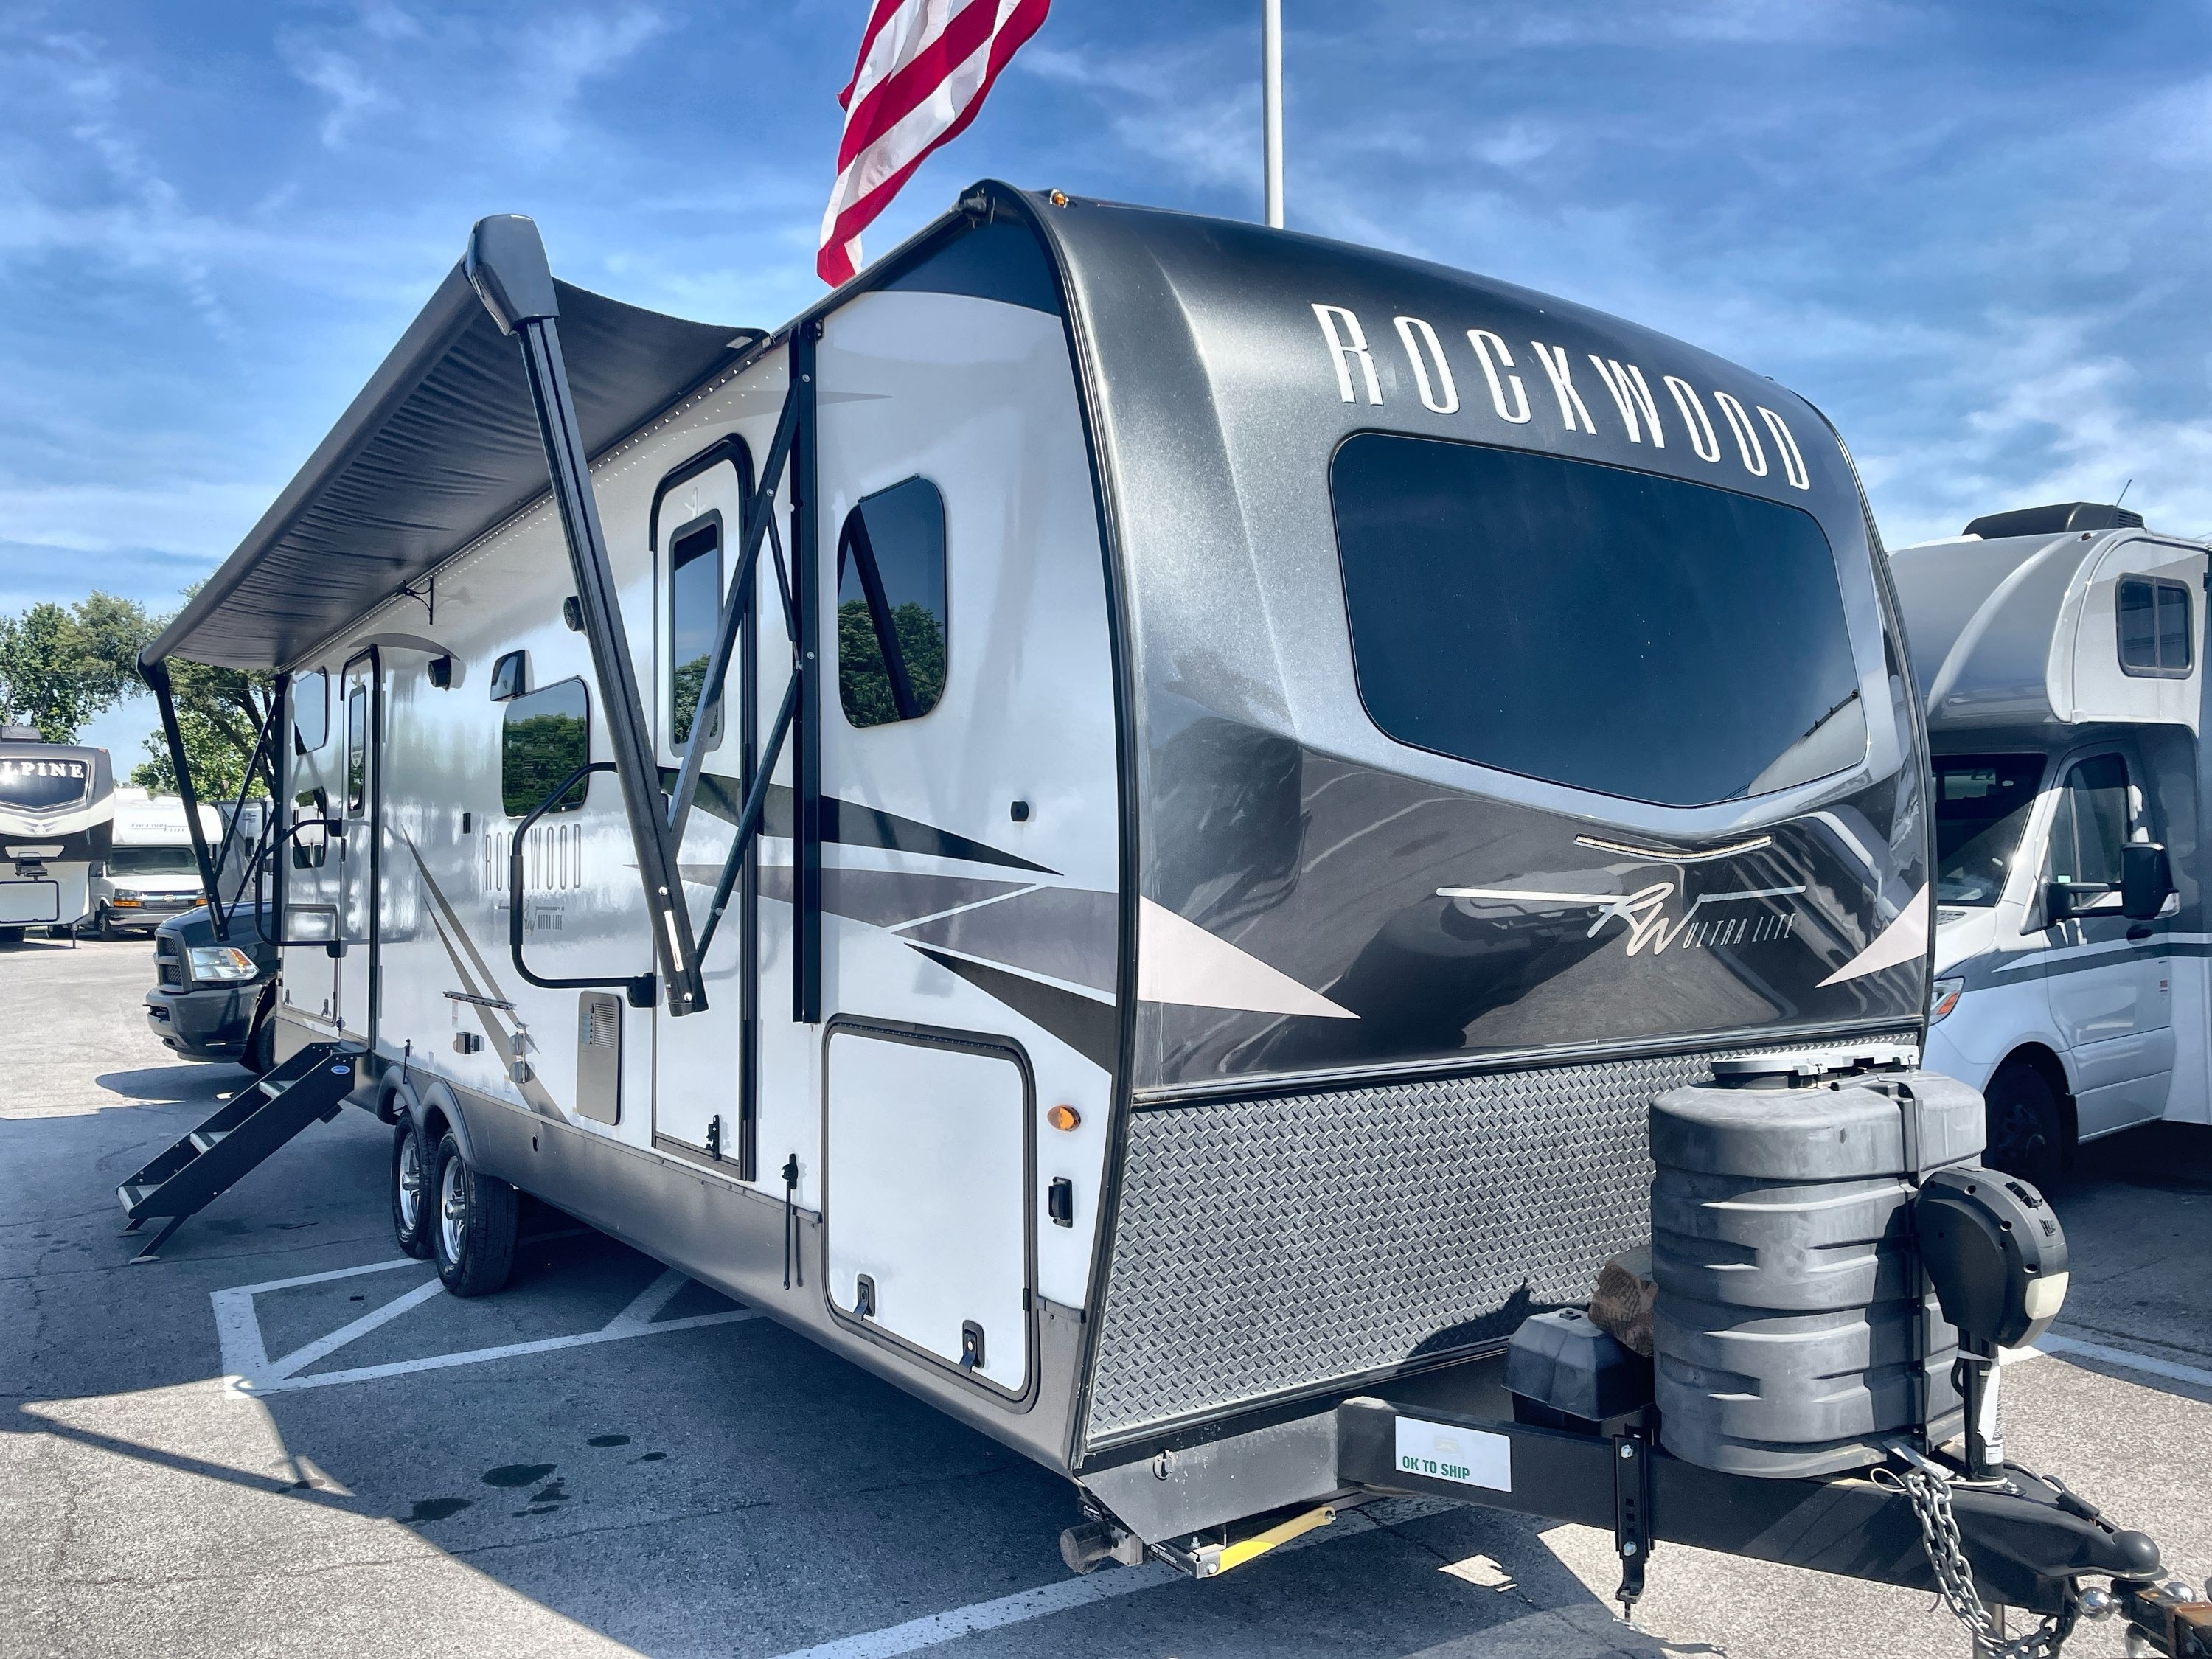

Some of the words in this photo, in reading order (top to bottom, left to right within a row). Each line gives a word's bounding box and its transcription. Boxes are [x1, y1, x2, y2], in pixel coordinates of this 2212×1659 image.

[1311, 303, 1810, 490] ROCKWOOD
[485, 824, 581, 891] ROCWOOD
[1682, 918, 1747, 949] ULTRA
[1752, 913, 1797, 942] LITE
[1402, 1455, 1419, 1470] OK
[1422, 1459, 1437, 1474] TO
[1441, 1464, 1470, 1479] SHIP
